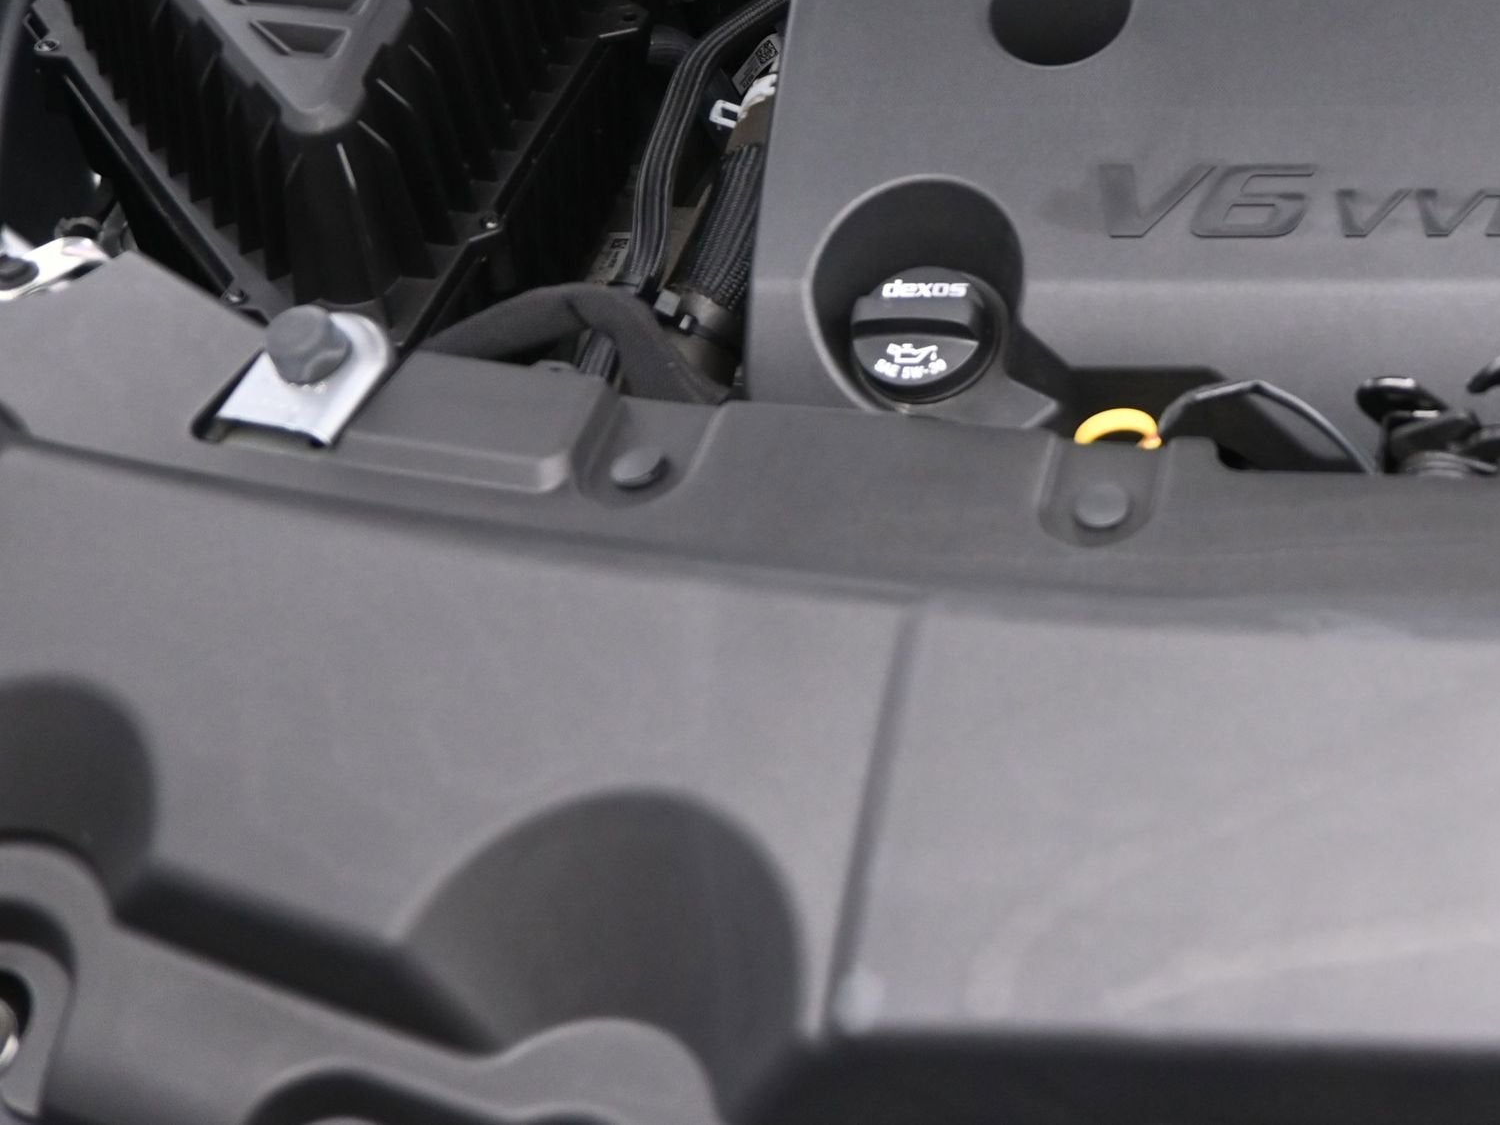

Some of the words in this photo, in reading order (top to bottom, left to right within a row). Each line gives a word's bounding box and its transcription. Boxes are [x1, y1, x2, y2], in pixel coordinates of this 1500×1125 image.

[1098, 162, 1318, 237] V6
[882, 279, 970, 298] dexos
[874, 359, 900, 378] SAE
